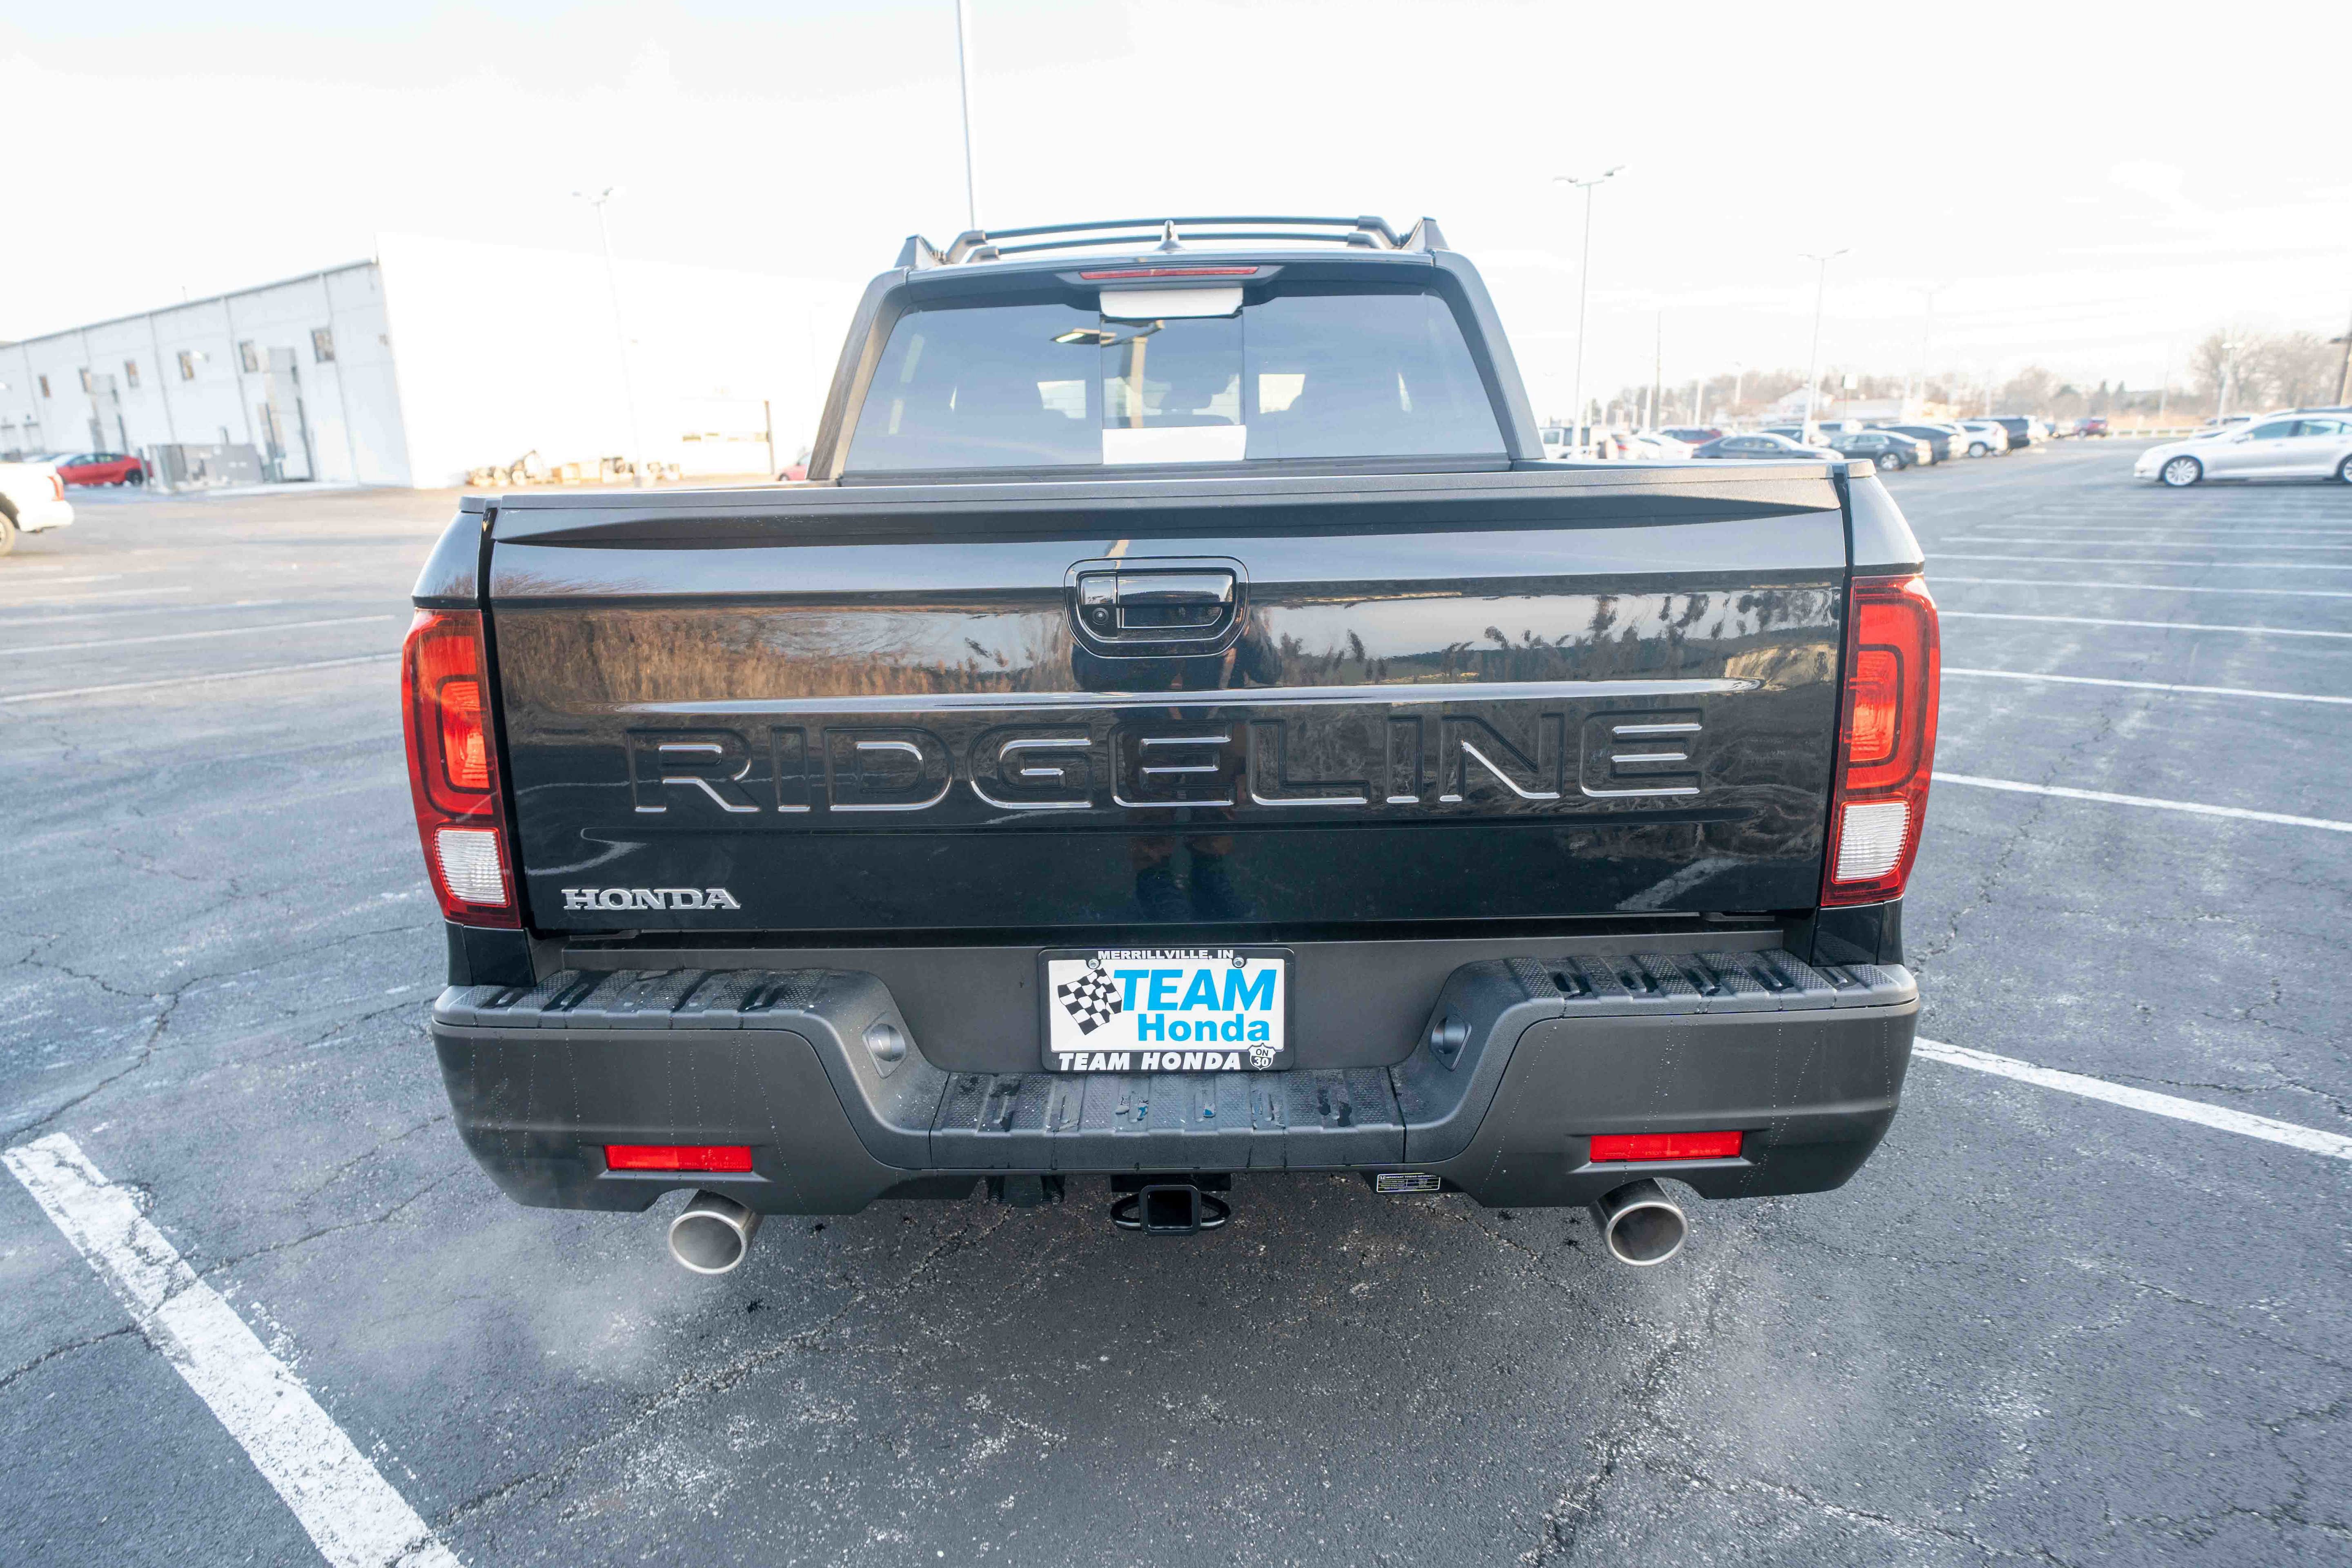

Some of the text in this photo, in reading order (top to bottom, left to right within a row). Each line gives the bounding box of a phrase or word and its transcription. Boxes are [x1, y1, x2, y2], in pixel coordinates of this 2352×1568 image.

[628, 708, 1703, 813] RIDGELINE
[561, 888, 742, 910] HONDA
[1098, 950, 1234, 960] MERRILLVILLE, IN
[1114, 969, 1276, 1011] TEAM
[1138, 1014, 1270, 1041] Honda
[1059, 1052, 1241, 1071] TEAM HONDA
[1254, 1057, 1269, 1067] 30
